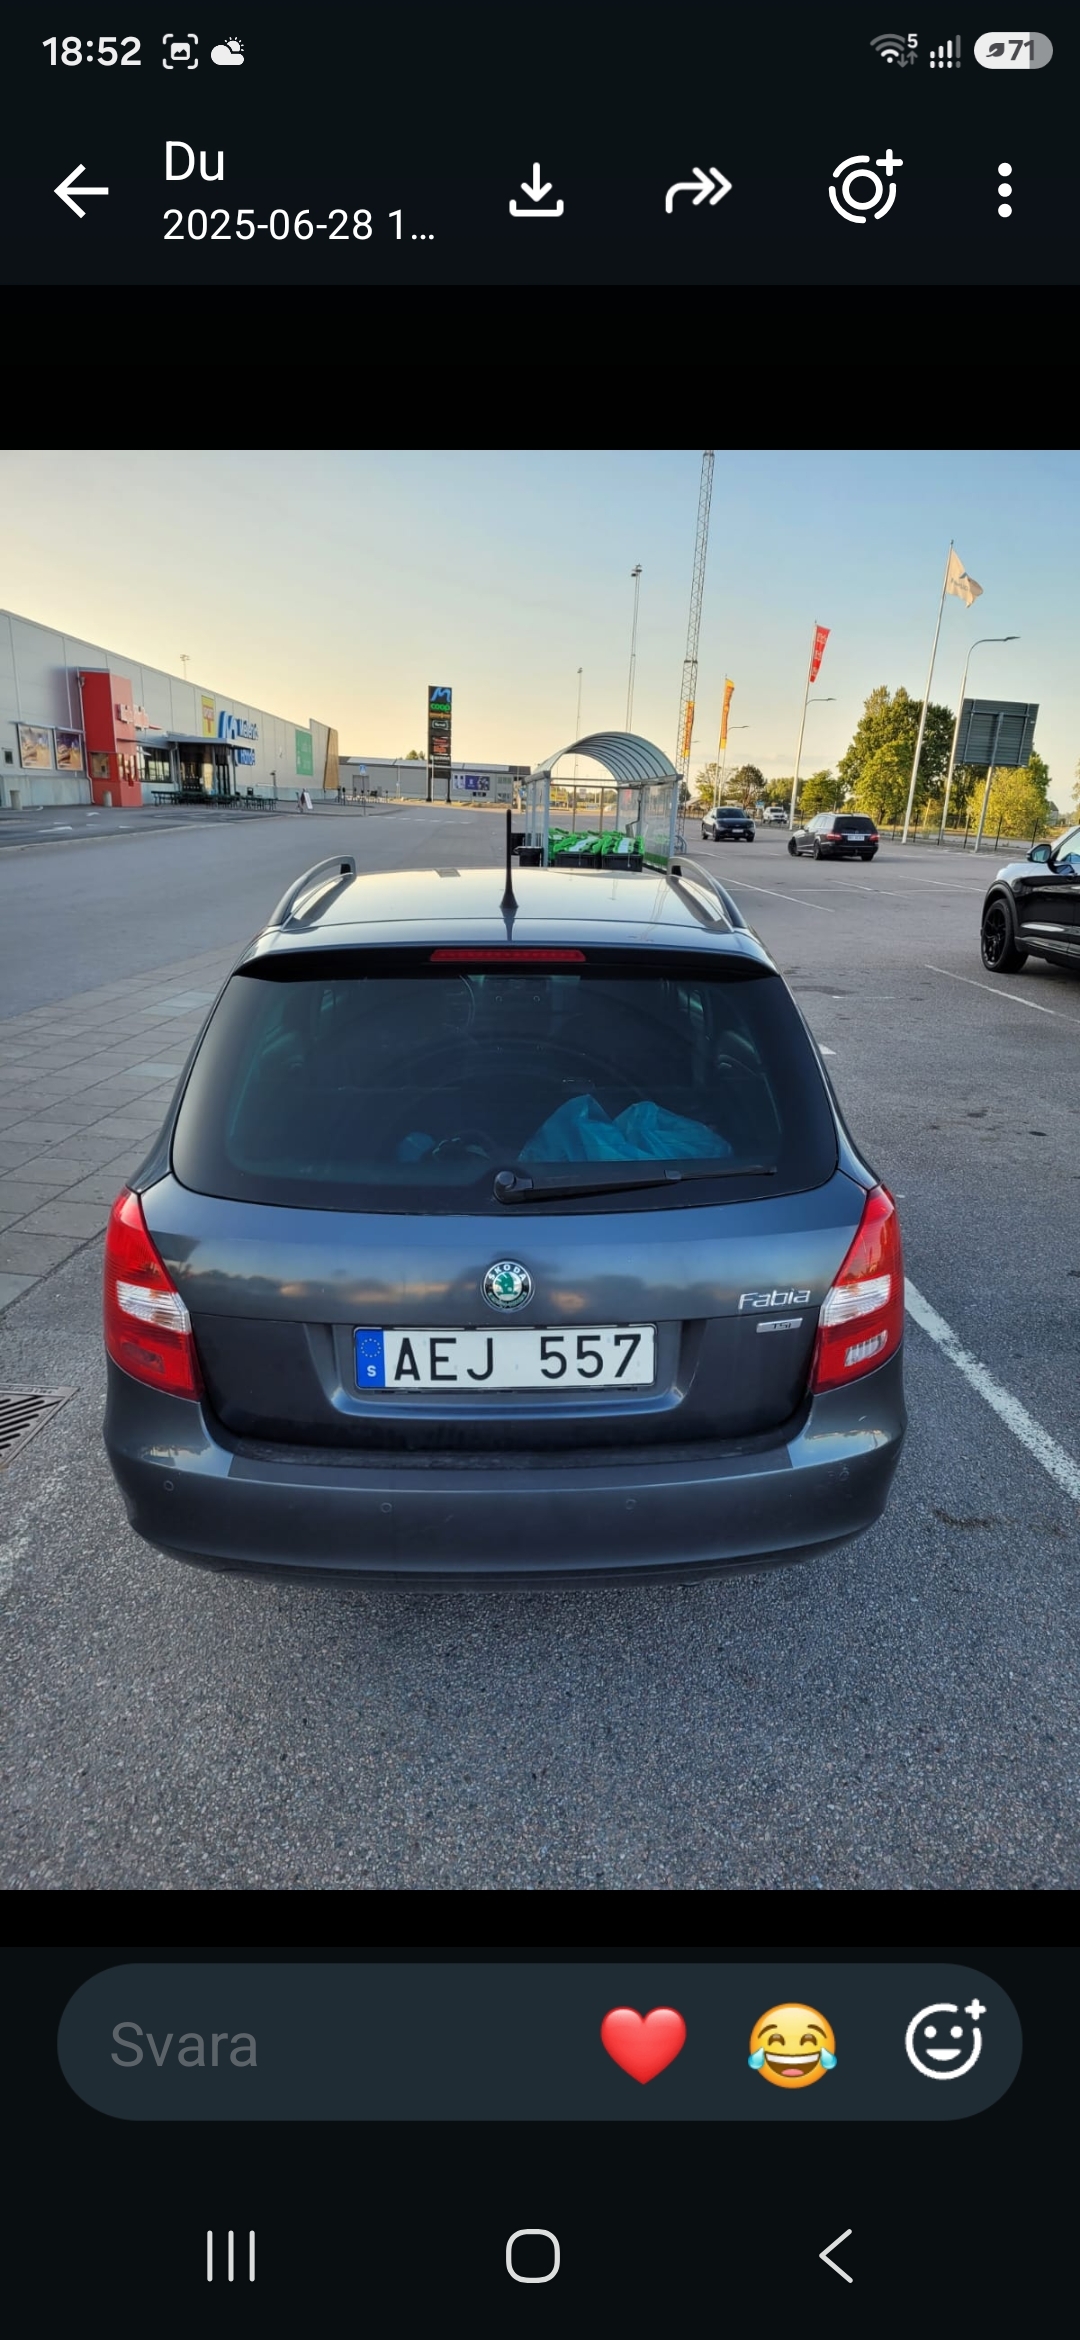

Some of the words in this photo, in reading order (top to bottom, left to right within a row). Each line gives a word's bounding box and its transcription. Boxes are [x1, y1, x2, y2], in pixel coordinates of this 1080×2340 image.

[430, 703, 451, 713] coop
[738, 1288, 811, 1310] Fabia
[394, 1337, 494, 1381] AEJ
[540, 1334, 642, 1379] 557
[366, 1365, 377, 1377] S
